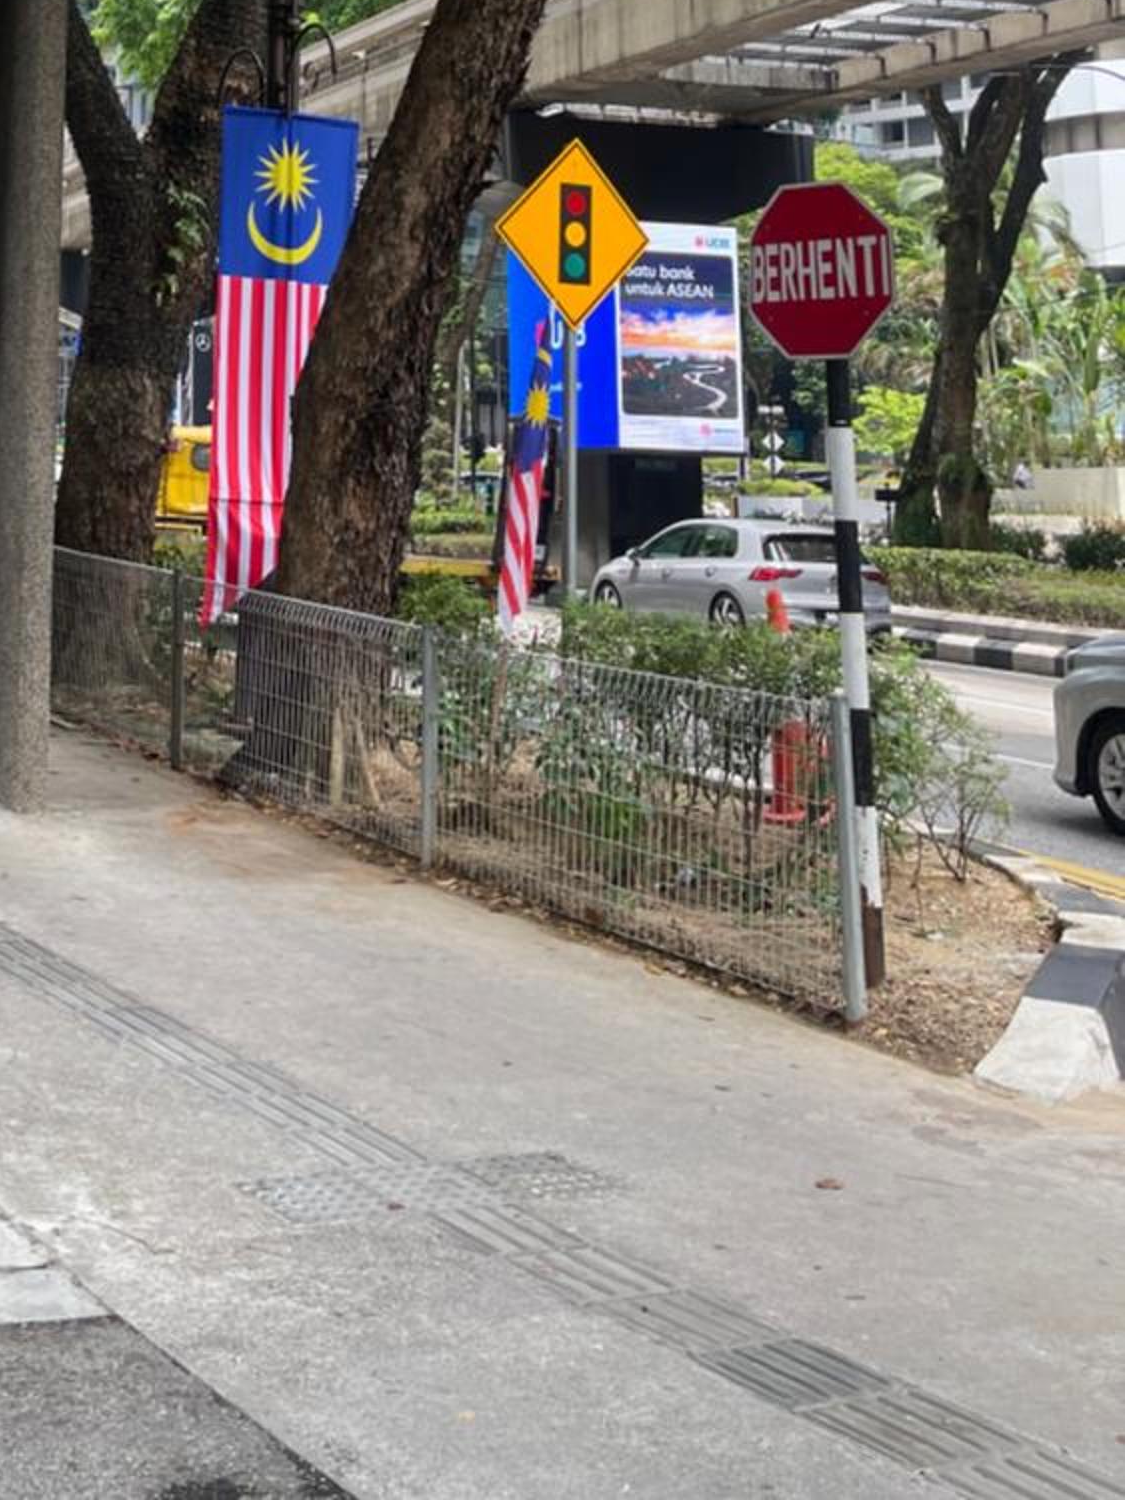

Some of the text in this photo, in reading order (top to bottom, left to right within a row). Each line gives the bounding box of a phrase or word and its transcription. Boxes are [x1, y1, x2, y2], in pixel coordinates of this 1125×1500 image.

[659, 264, 695, 280] bank
[752, 234, 890, 304] BERHENTI
[625, 281, 714, 299] untuk ASEAN
